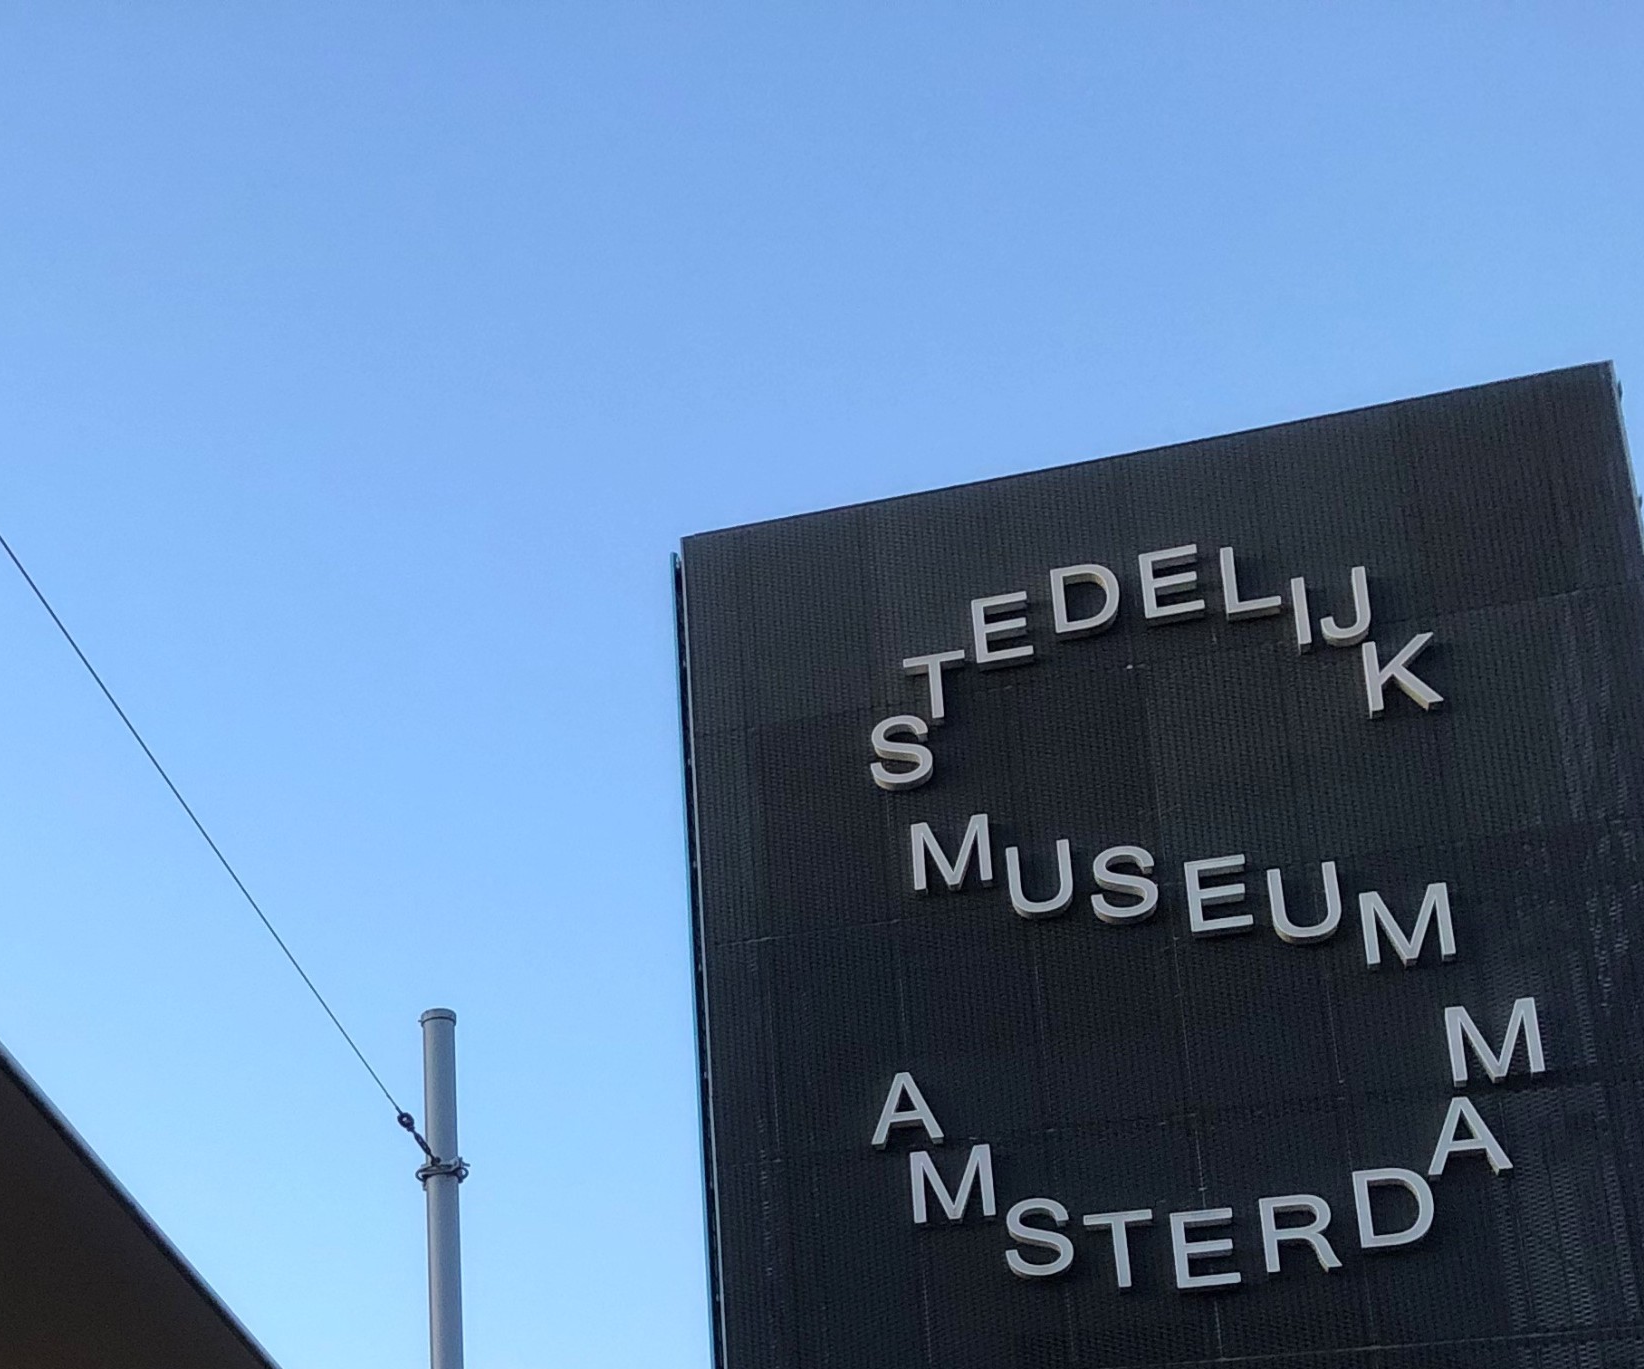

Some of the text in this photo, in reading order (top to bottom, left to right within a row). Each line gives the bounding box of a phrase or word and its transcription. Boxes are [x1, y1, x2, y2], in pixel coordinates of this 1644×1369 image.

[870, 543, 1443, 791] STEDELIJK
[910, 813, 1457, 969] MUSEUM
[871, 996, 1545, 1290] AMSTERDAM
